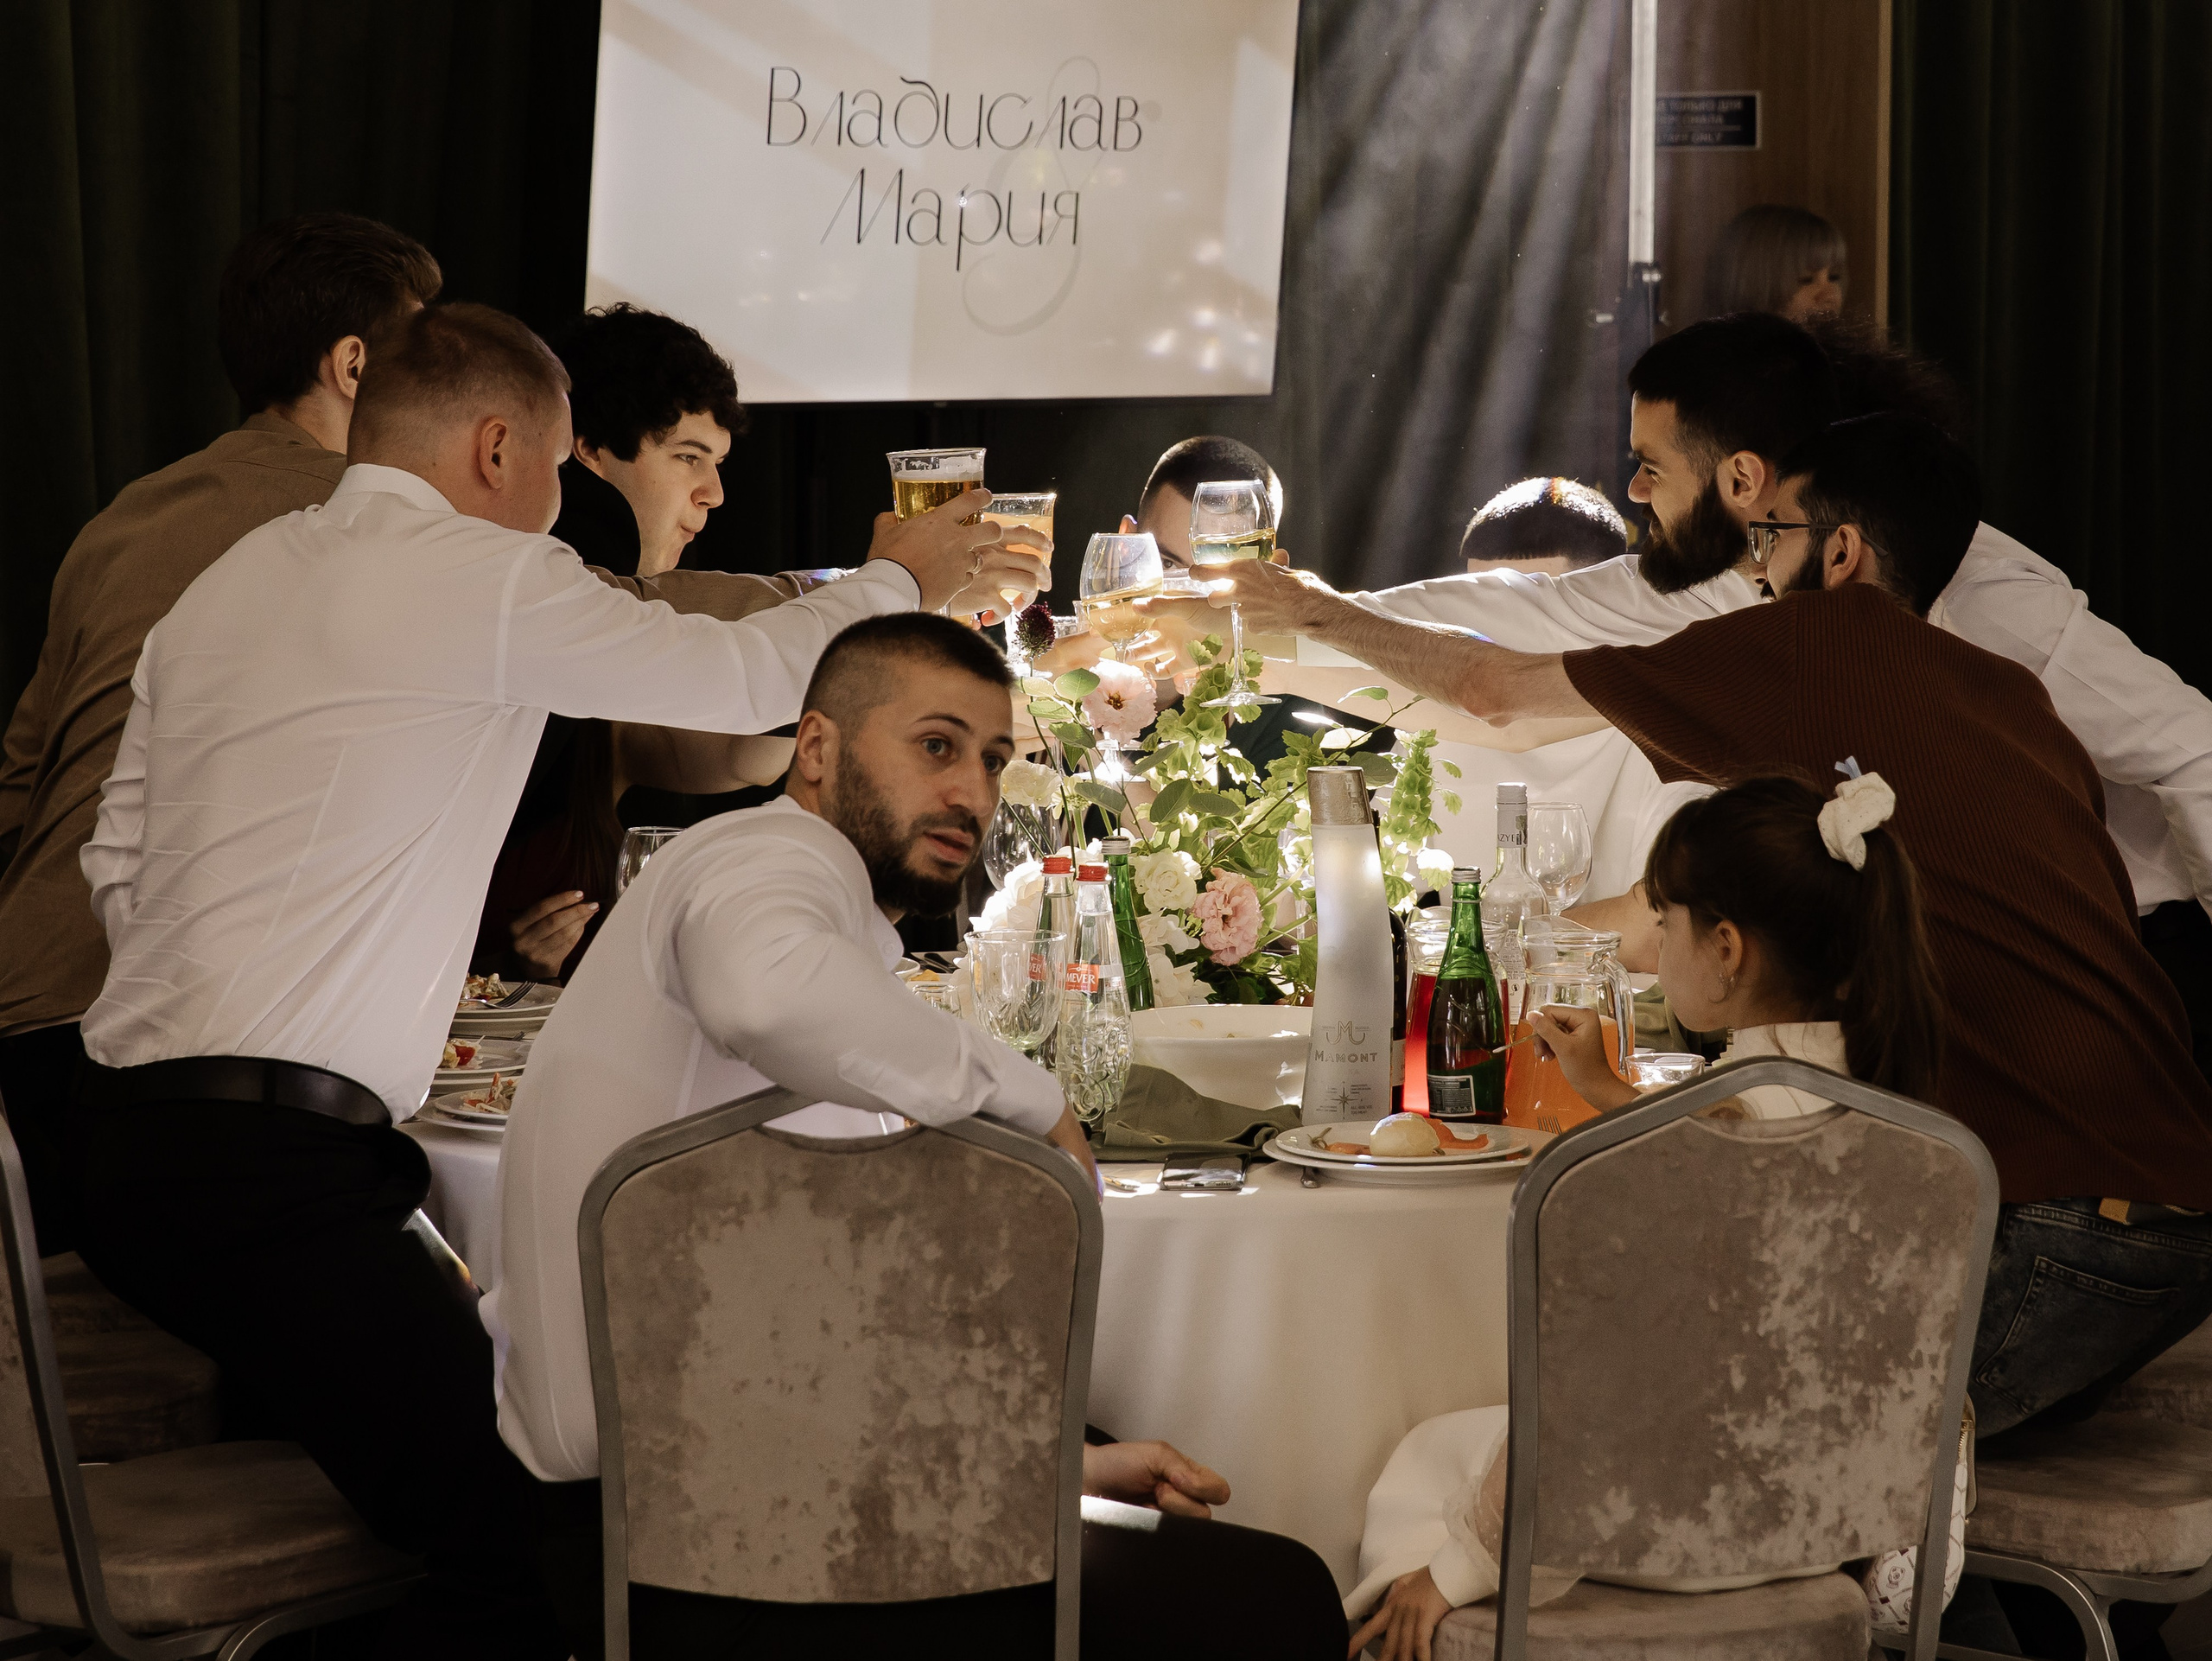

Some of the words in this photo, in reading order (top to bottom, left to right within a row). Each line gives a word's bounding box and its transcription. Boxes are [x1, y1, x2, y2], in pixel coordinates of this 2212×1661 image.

[766, 66, 1142, 151] Владислав
[820, 167, 1080, 271] Мария
[1066, 972, 1096, 984] MEVER
[1314, 1049, 1378, 1063] MAMONT
